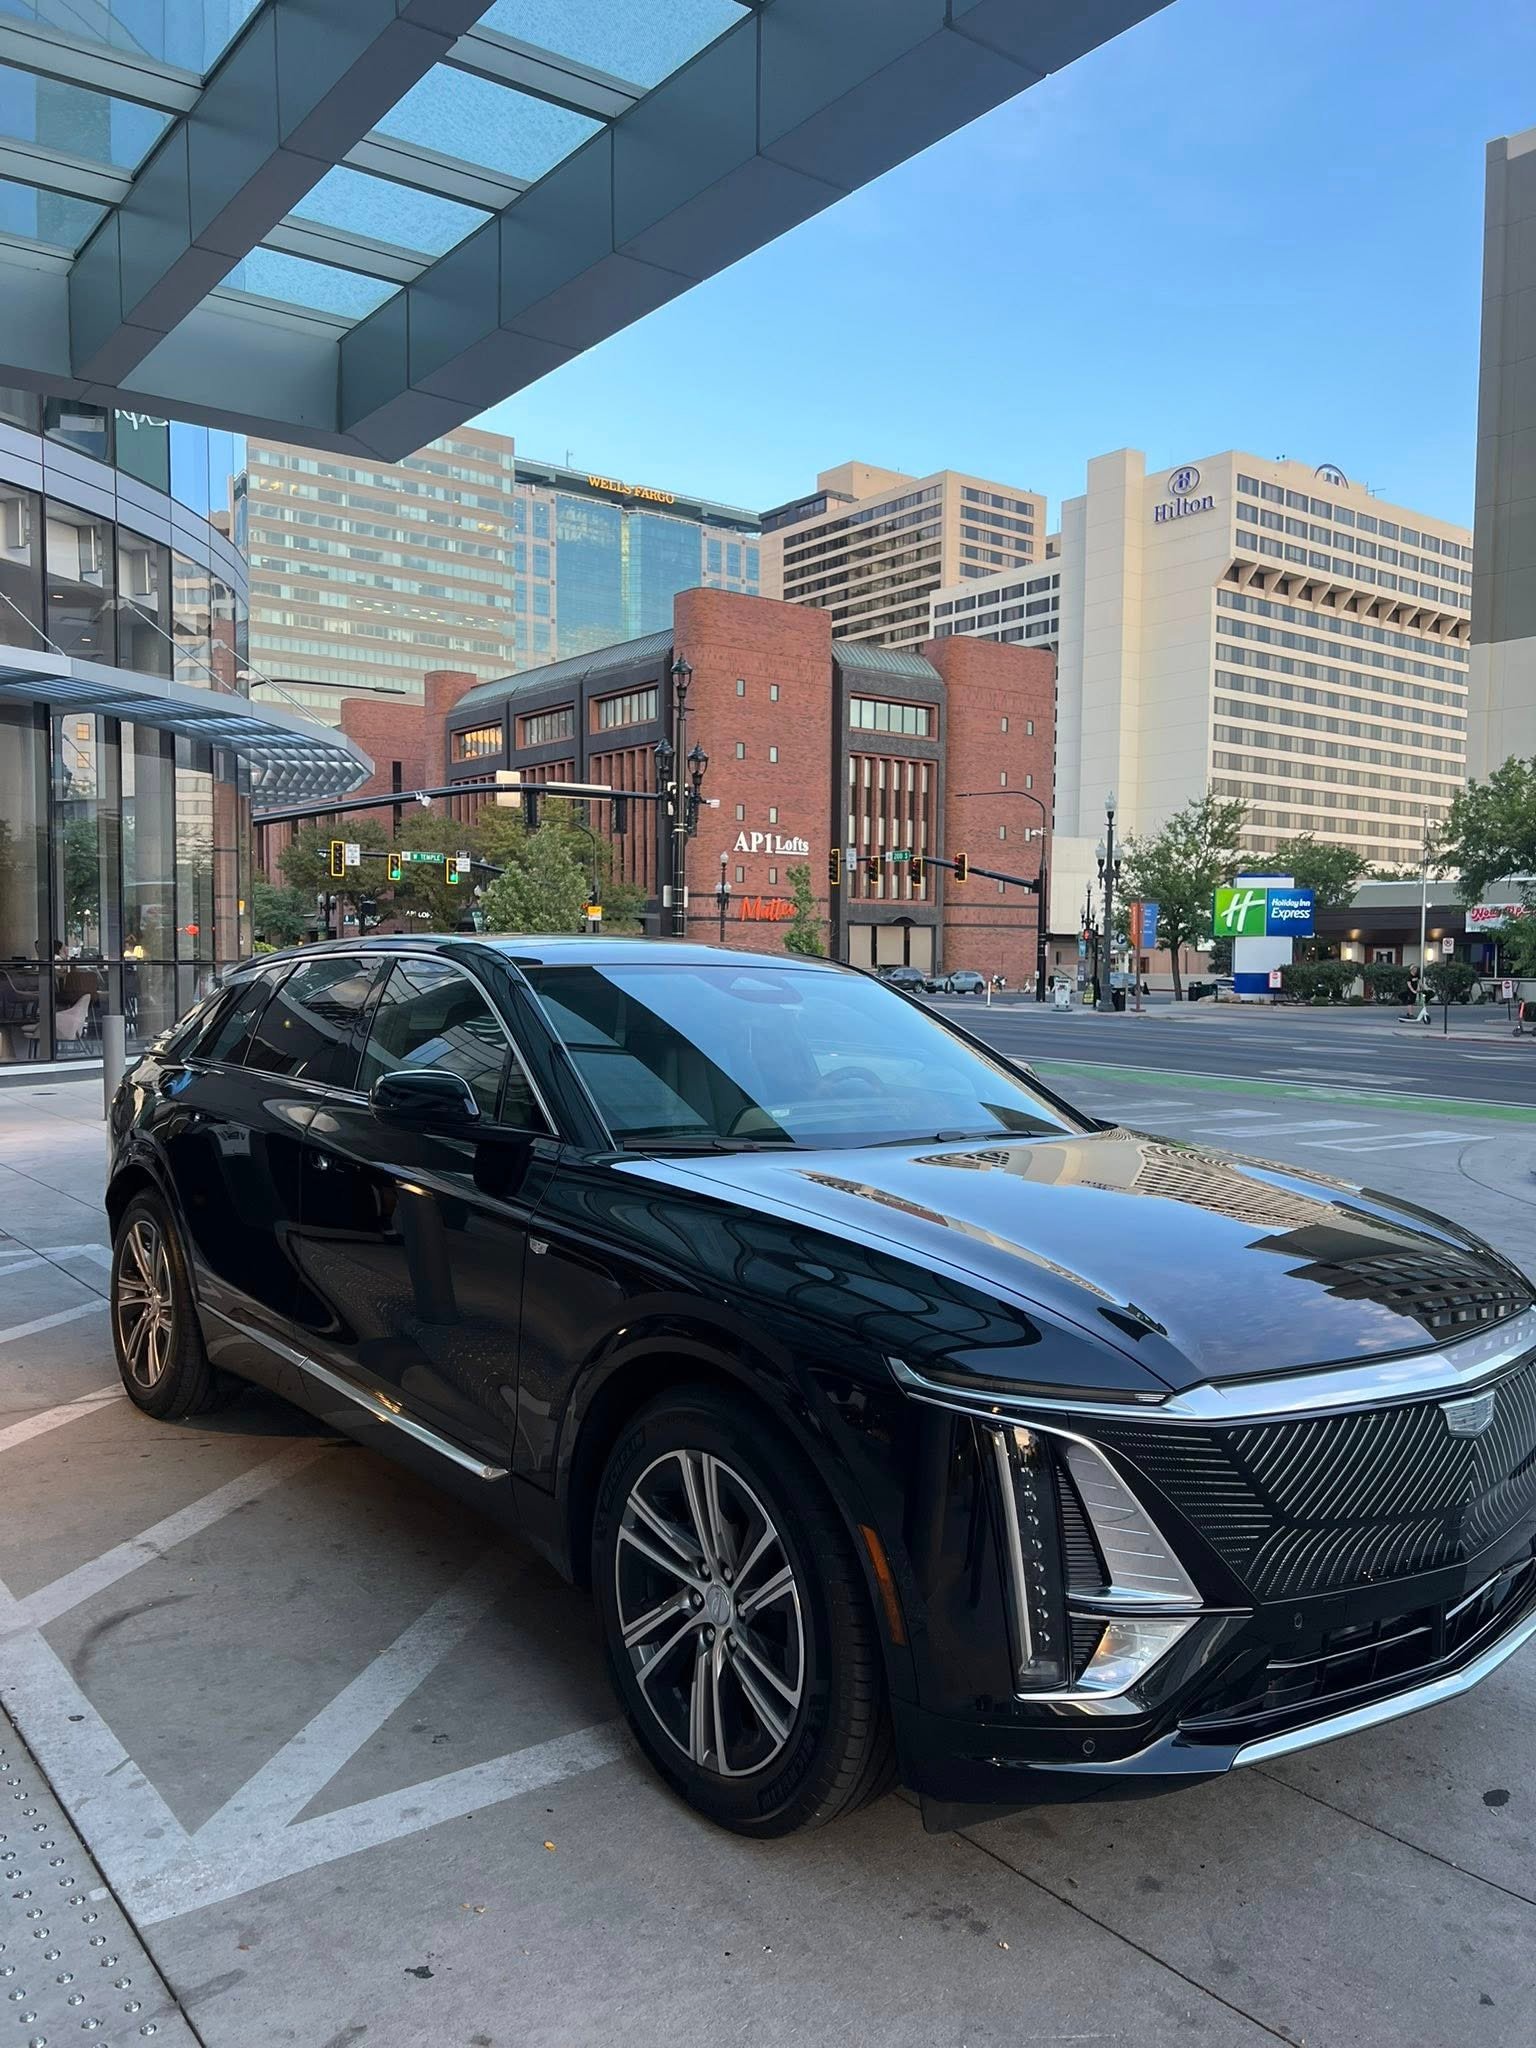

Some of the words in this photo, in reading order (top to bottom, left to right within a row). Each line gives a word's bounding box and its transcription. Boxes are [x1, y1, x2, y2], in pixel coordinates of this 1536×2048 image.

[588, 475, 632, 495] WELLS
[634, 486, 675, 504] FARGO
[1154, 494, 1215, 523] Hilton
[733, 831, 773, 853] AP1
[774, 835, 809, 852] Lofts
[421, 853, 441, 862] TEMPLE
[893, 852, 903, 860] 200
[1271, 898, 1300, 909] Holiday
[1299, 898, 1311, 907] Inn
[1271, 907, 1311, 920] Express
